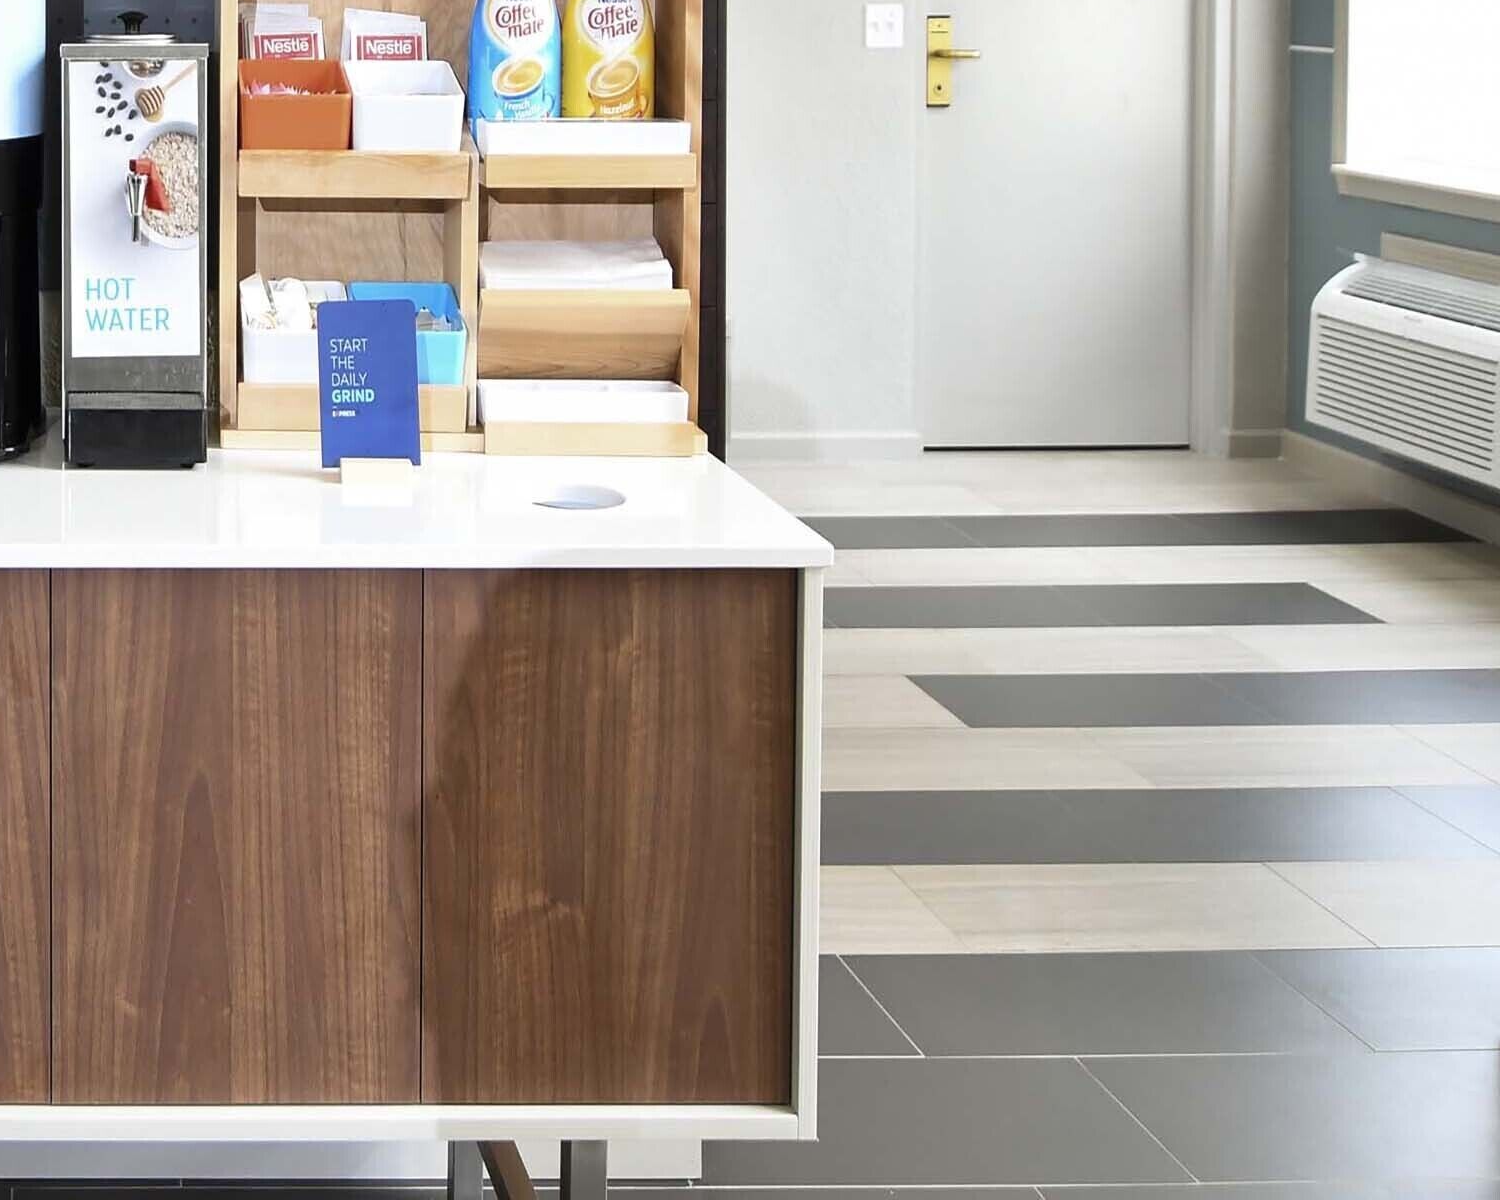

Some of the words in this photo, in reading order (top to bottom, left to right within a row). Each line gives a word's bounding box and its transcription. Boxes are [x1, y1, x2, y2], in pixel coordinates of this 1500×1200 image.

[507, 18, 545, 40] mate
[600, 17, 639, 40] mate
[263, 36, 310, 54] Nestlé
[365, 38, 413, 55] Nestlé
[85, 277, 136, 301] HOT
[85, 307, 170, 331] WATER
[330, 338, 368, 353] START
[330, 355, 355, 370] THE
[331, 372, 368, 387] DAILY
[332, 388, 375, 403] GRIND
